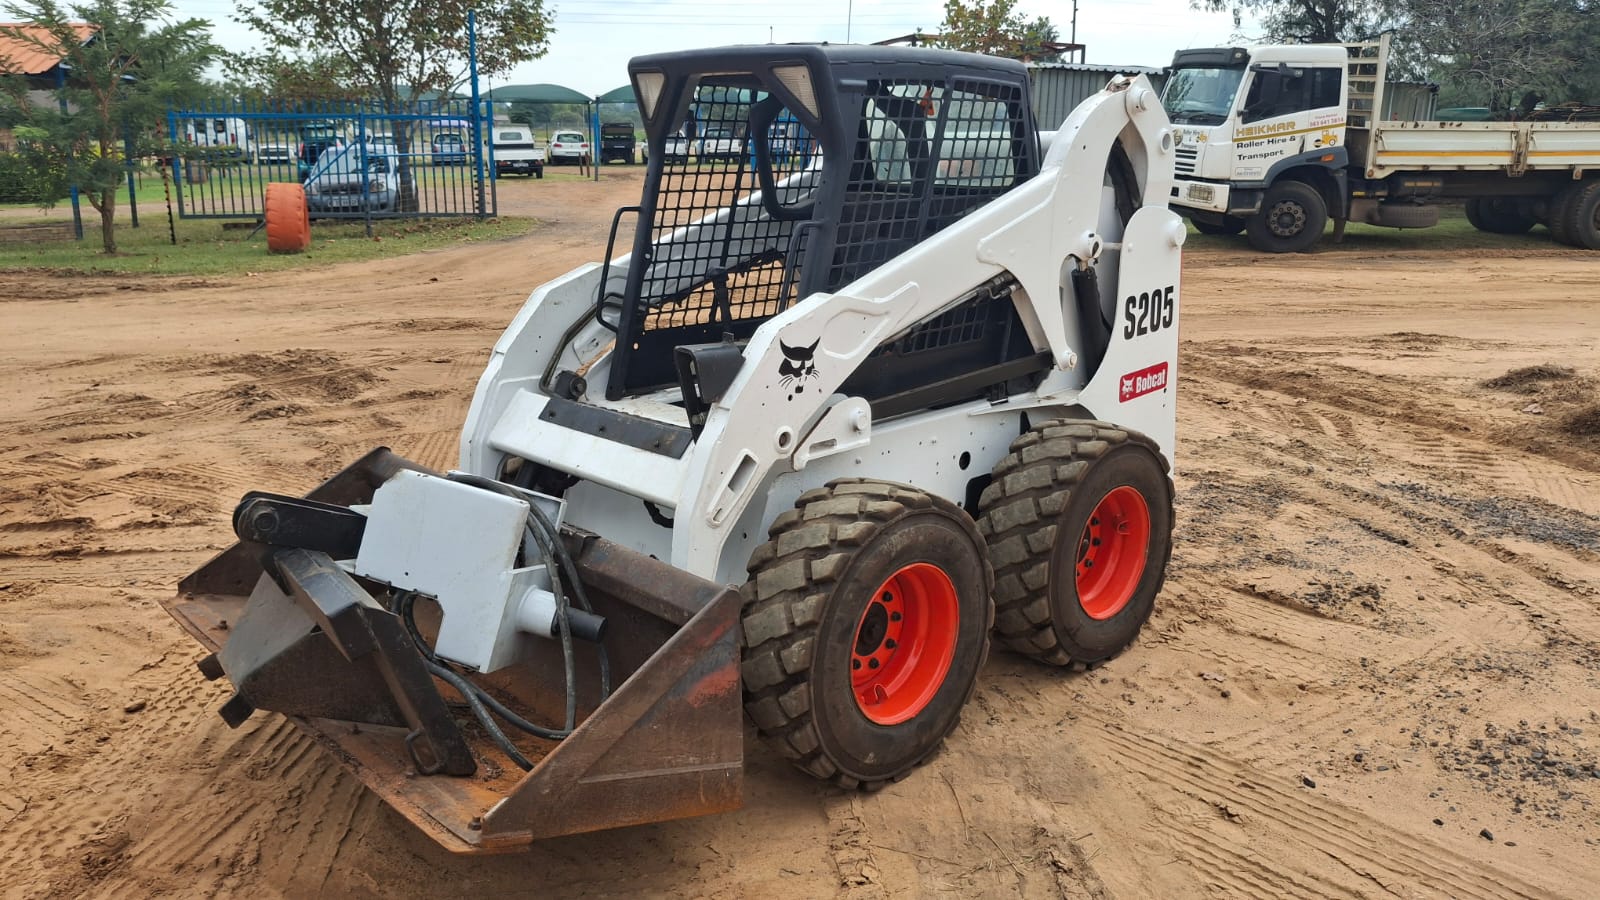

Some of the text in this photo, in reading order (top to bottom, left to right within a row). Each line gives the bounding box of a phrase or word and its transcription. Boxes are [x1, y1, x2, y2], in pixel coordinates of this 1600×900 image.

[1236, 121, 1296, 137] HEIKMAR
[1236, 139, 1265, 149] Roller
[1267, 137, 1287, 145] Hire
[1237, 149, 1284, 161] Transport
[1124, 285, 1174, 340] S205
[1136, 369, 1166, 393] Bobcat
